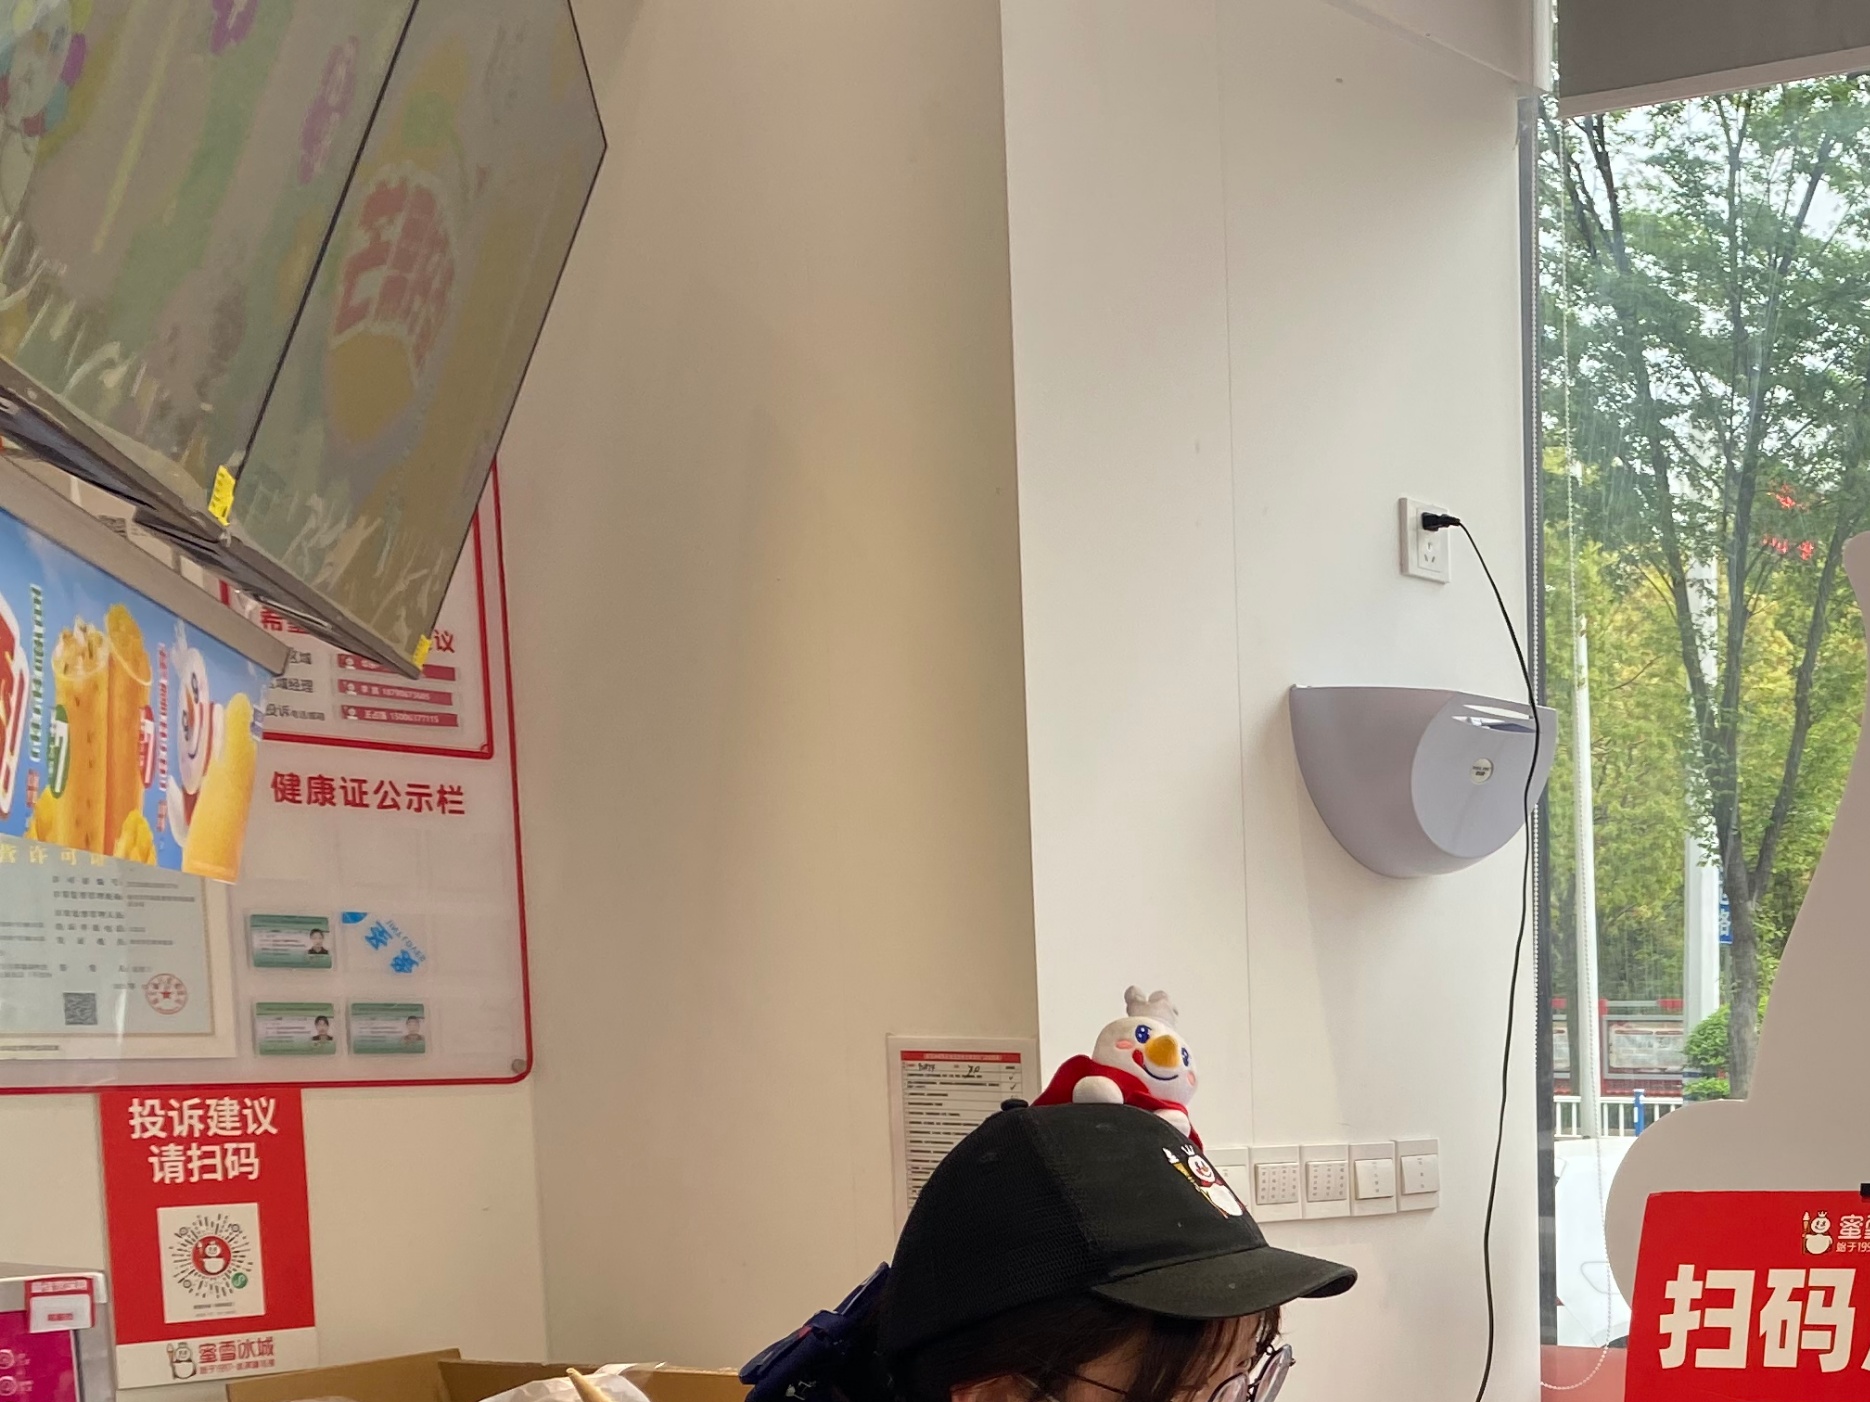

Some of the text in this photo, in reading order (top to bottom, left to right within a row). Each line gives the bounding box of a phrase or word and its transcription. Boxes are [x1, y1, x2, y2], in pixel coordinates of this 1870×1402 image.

[271, 771, 465, 815] 健康证公示栏
[128, 1096, 279, 1140] 投诉建议
[148, 1143, 261, 1185] 请扫码
[198, 1336, 275, 1364] 蜜雪冰城
